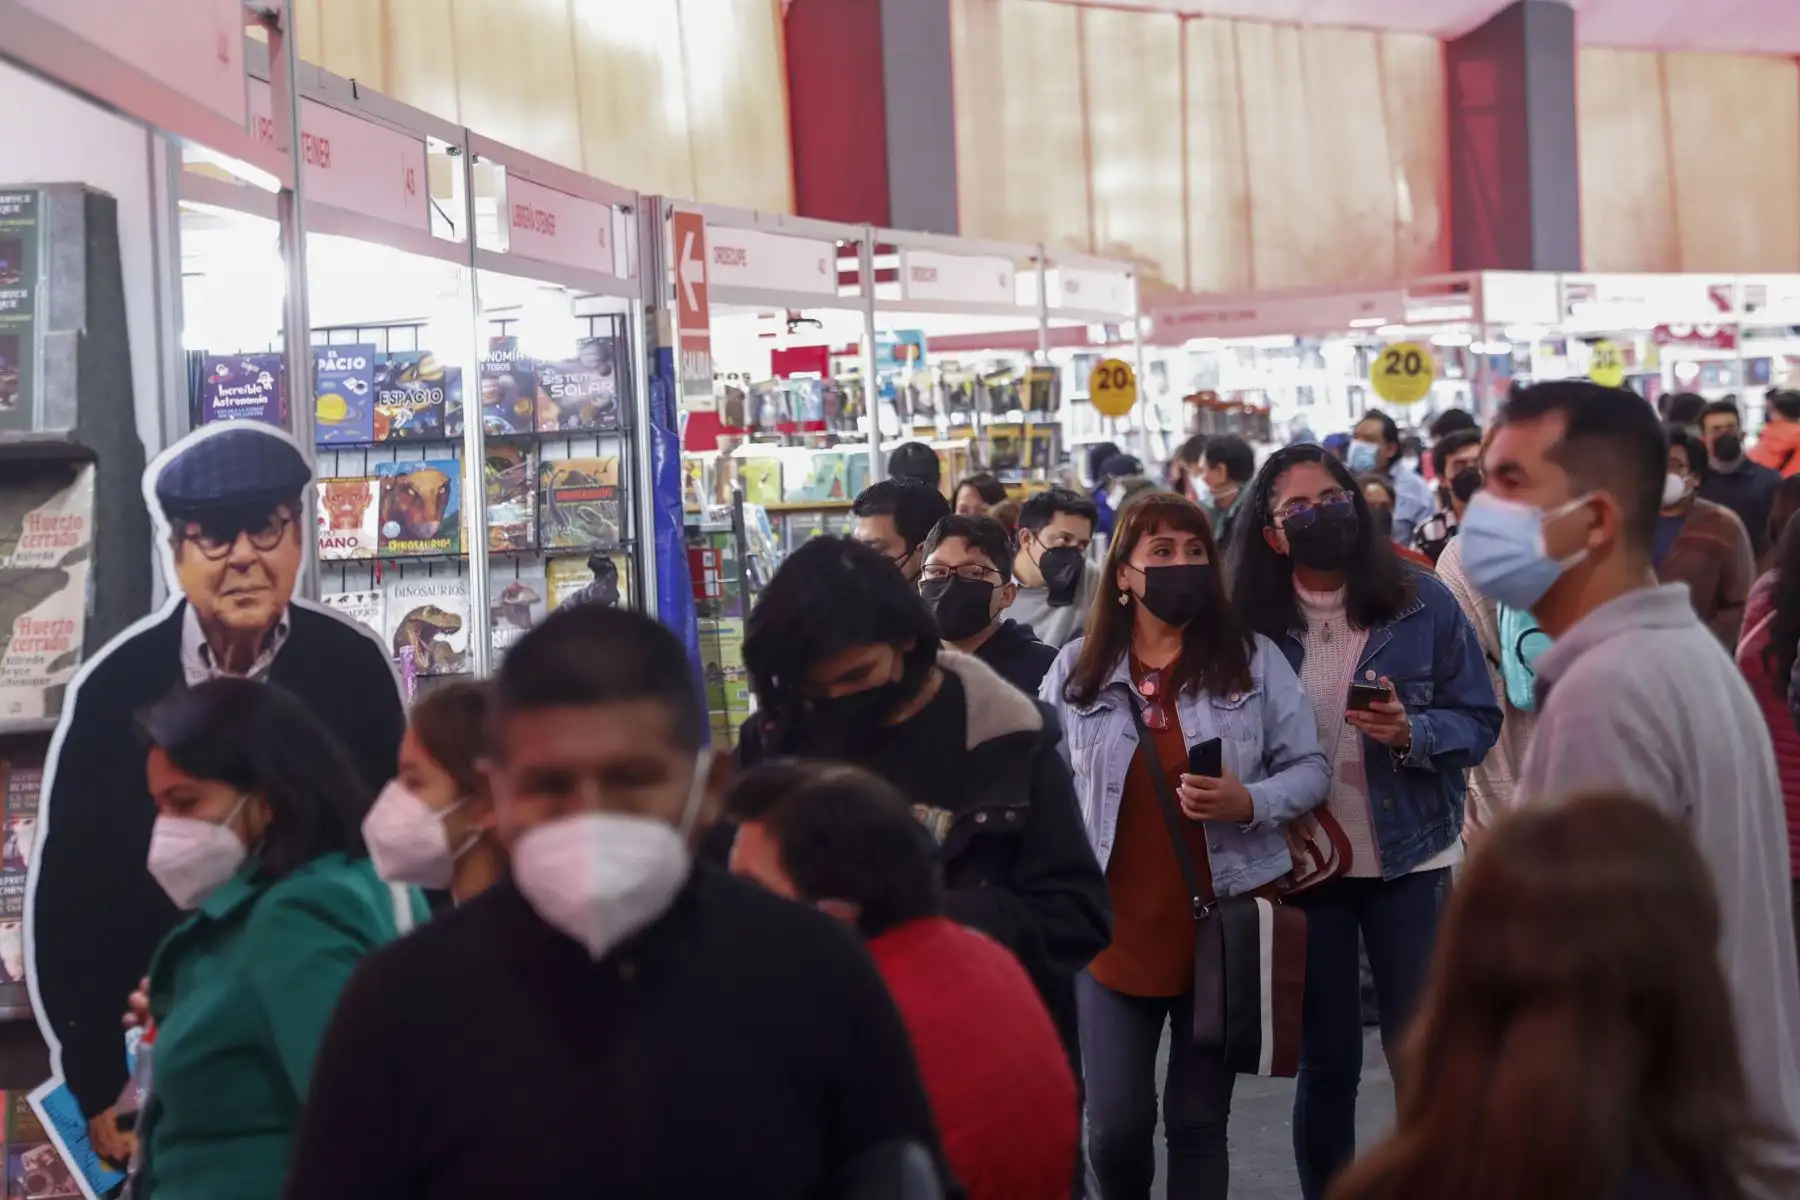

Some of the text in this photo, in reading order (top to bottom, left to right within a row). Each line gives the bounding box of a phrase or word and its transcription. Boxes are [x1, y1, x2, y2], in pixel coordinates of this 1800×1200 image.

[301, 132, 331, 168] TEINER
[318, 357, 366, 371] PACIO
[379, 387, 444, 405] ESPACIO
[550, 382, 615, 399] SOLAR
[212, 395, 269, 409] Astronomía
[27, 512, 83, 533] Huerto
[394, 583, 465, 598] DINOSAURIOS
[14, 616, 76, 635] Huerto
